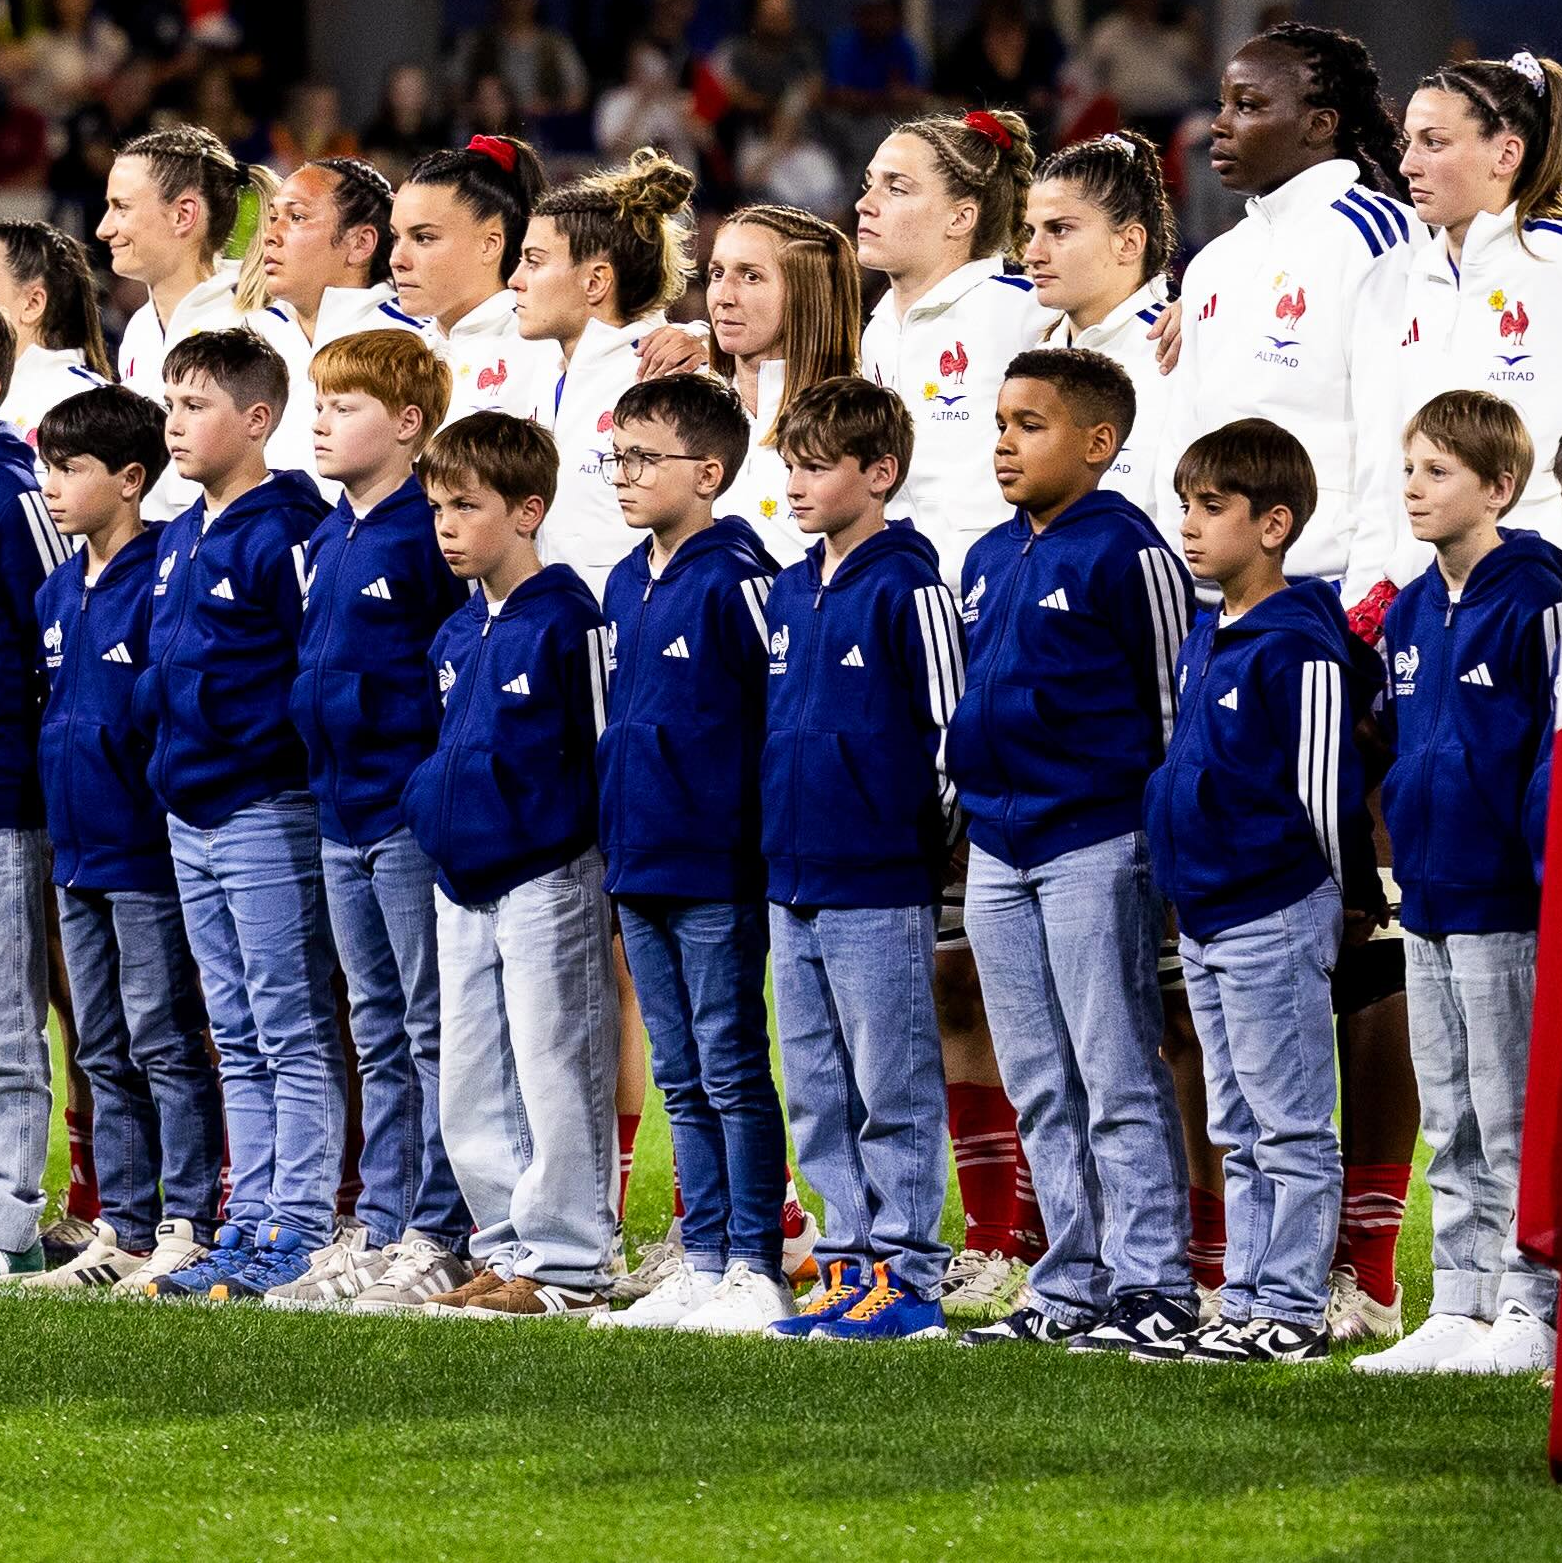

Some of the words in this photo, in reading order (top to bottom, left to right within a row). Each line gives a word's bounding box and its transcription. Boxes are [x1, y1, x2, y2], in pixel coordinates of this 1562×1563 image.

[1254, 350, 1299, 368] ALTRAD
[1487, 371, 1535, 382] ALTRAD
[930, 411, 970, 421] ALTRAD
[579, 463, 601, 474] ALT
